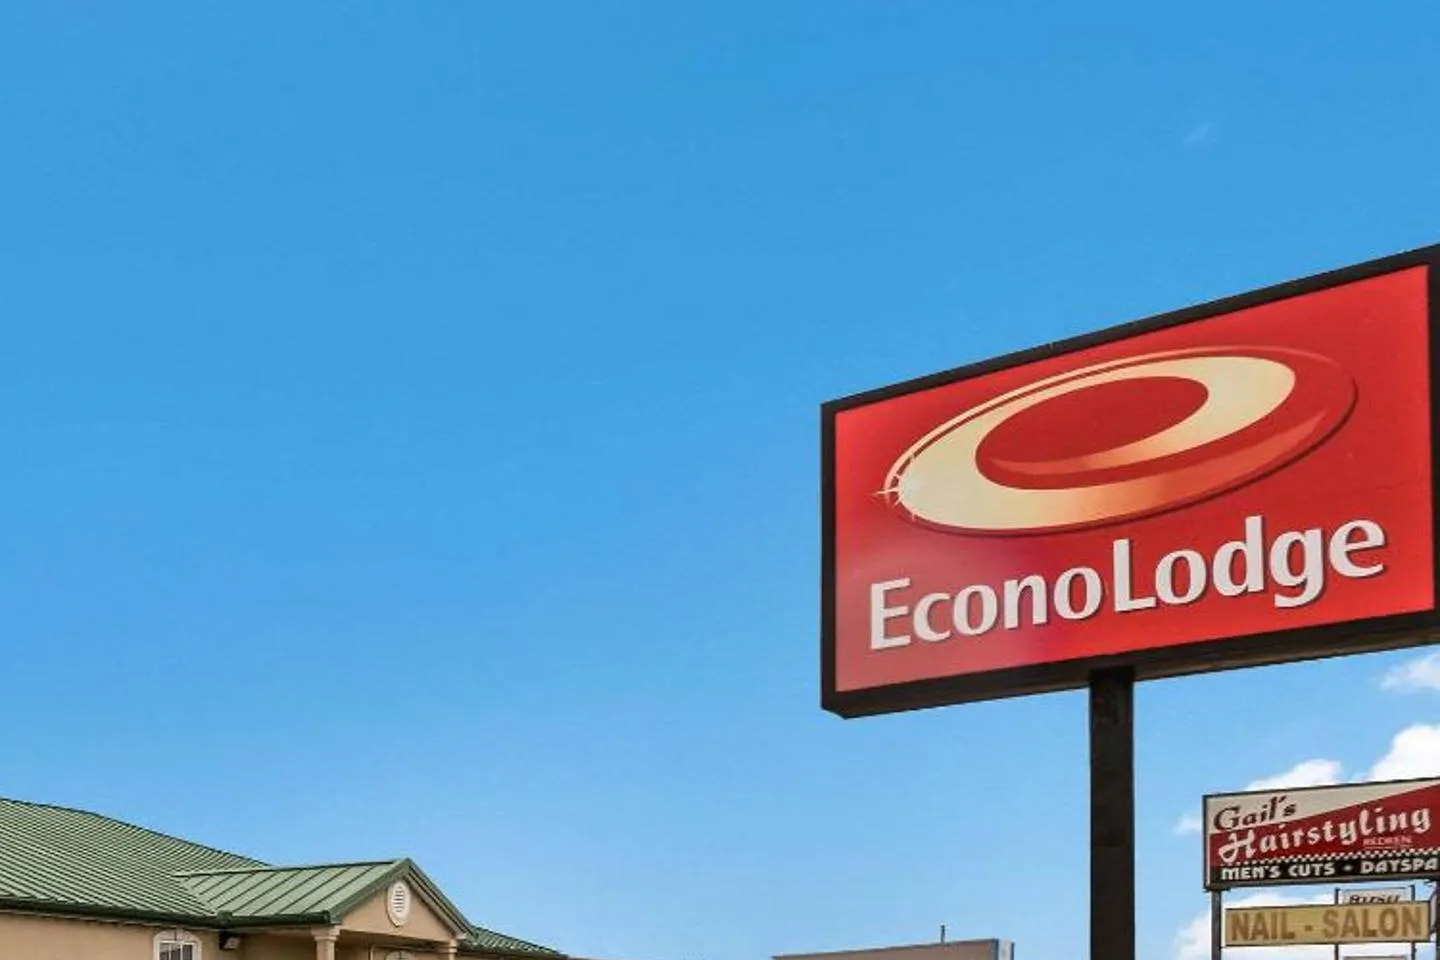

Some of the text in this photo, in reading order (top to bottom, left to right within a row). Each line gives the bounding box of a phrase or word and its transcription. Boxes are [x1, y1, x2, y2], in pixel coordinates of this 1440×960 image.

[869, 515, 1386, 650] EconoLodge
[1213, 796, 1296, 831] Gail's
[1218, 807, 1431, 863] Hairstyling
[1221, 858, 1438, 880] MEN'S CUTS DAYSPA
[1231, 907, 1422, 940] NAIL SALON
